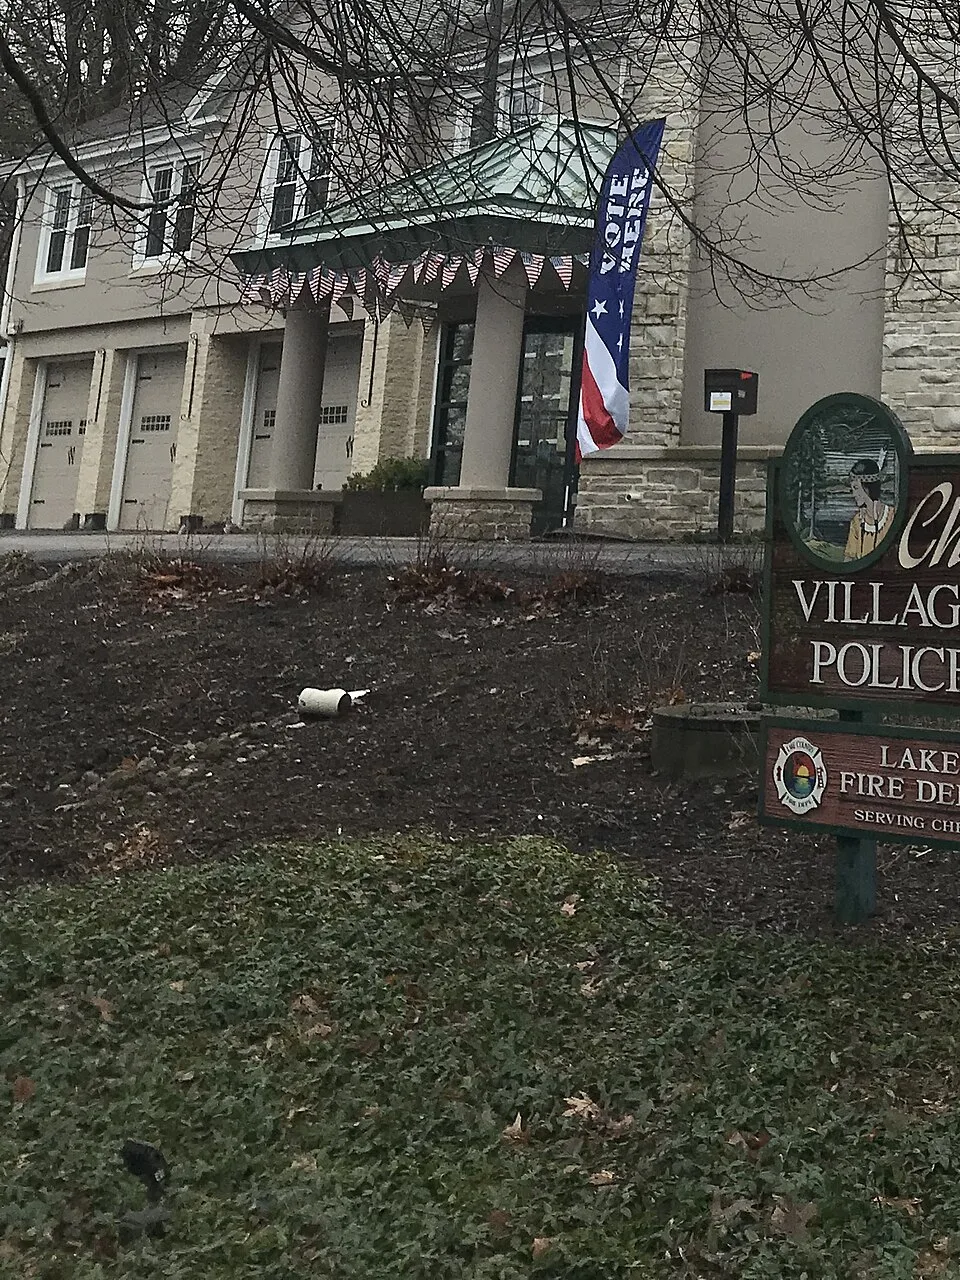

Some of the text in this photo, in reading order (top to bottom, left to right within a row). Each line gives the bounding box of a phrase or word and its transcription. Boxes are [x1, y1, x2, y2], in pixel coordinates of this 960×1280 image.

[600, 174, 629, 274] VOTE
[618, 168, 650, 274] HERE
[879, 746, 959, 774] LAKE
[839, 773, 904, 799] FIRE
[853, 809, 925, 829] SERVING
